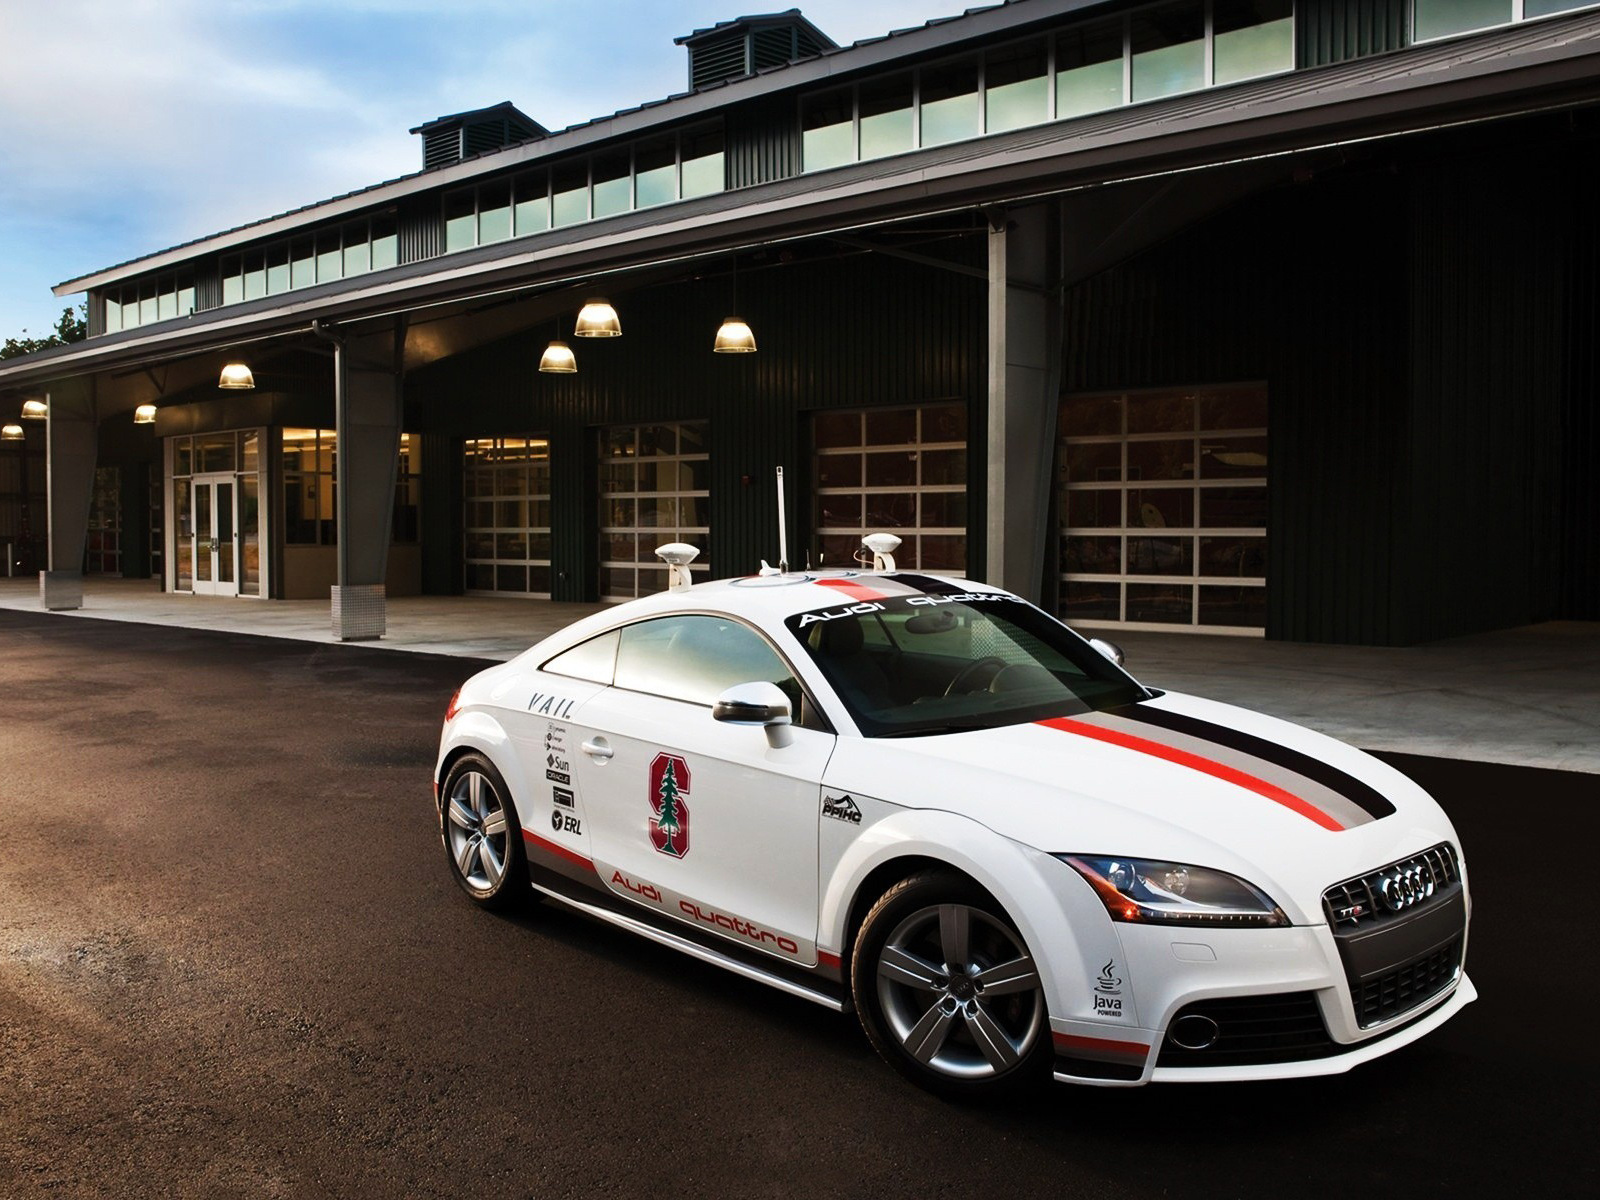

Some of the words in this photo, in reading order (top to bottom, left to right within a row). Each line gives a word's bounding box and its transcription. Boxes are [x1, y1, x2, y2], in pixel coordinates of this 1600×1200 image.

[798, 602, 886, 628] Audi
[527, 692, 575, 719] VAIL
[554, 755, 570, 772] Sun
[546, 771, 570, 784] ORACLE
[563, 815, 582, 836] ERL
[611, 870, 663, 903] Audi
[679, 900, 799, 954] quattro
[1092, 994, 1122, 1010] Java
[1097, 1009, 1122, 1017] POWERED
